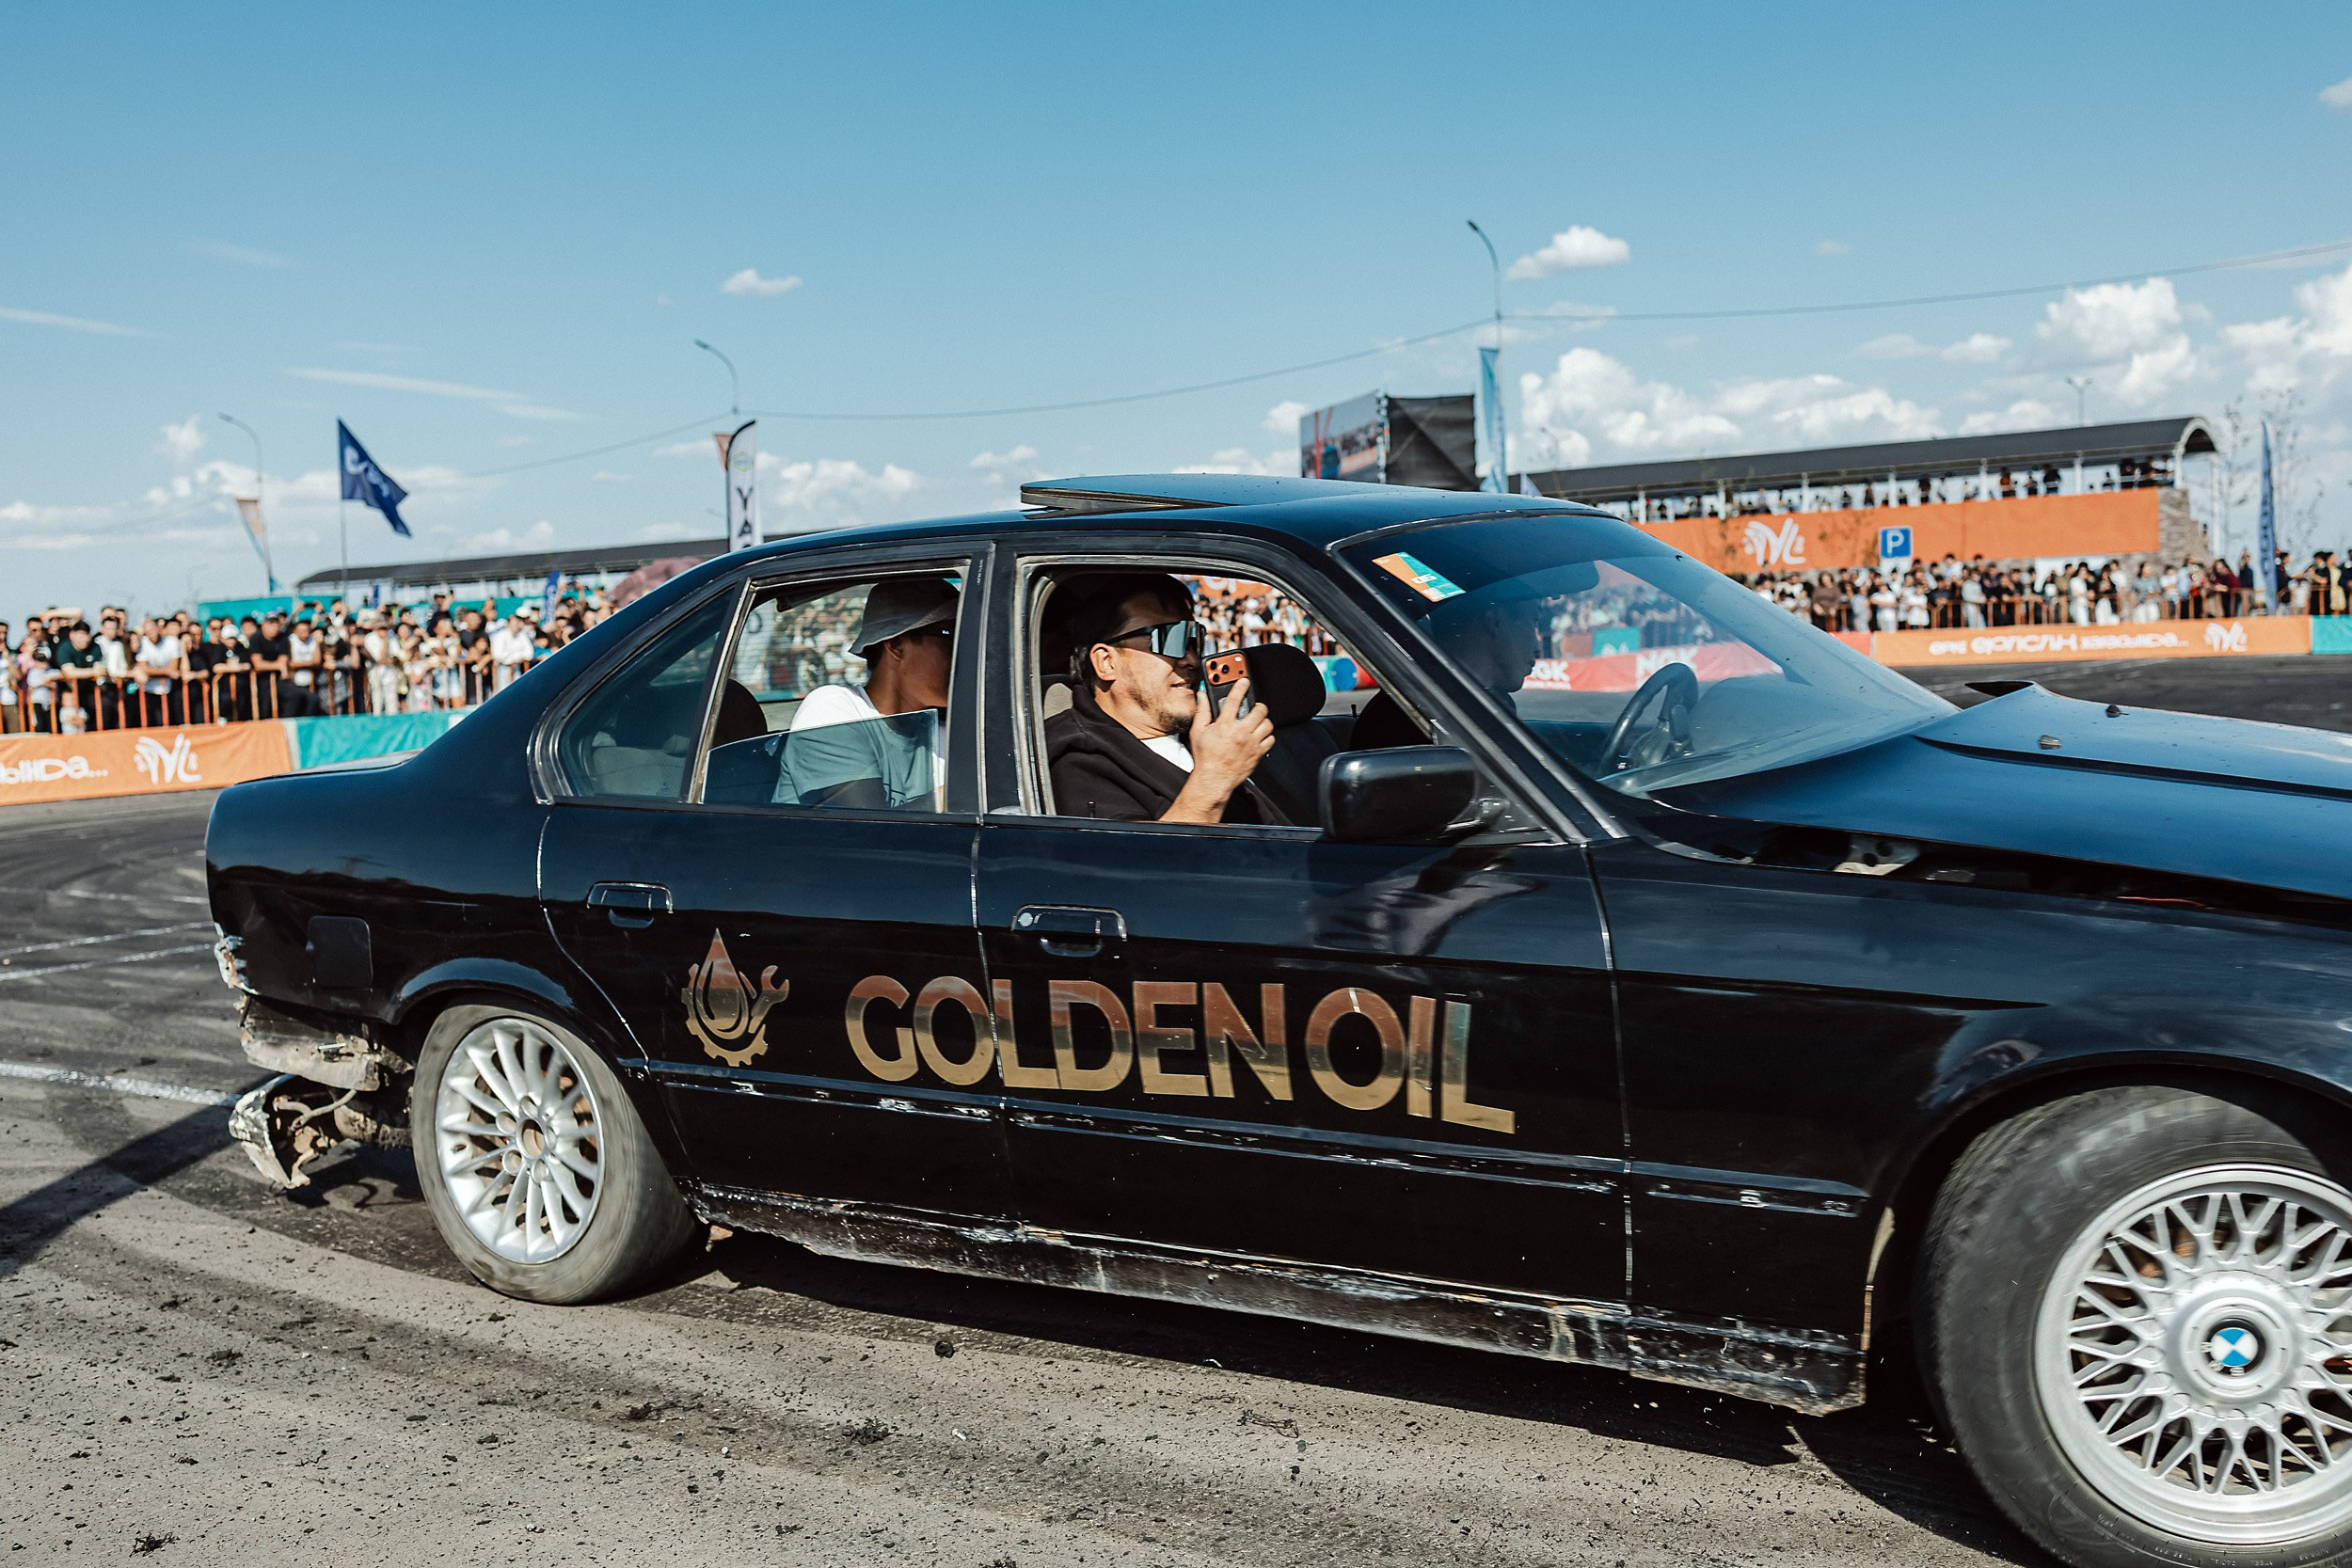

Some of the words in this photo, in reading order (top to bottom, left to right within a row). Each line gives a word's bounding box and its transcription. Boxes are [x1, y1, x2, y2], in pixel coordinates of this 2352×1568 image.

[1886, 530, 1904, 555] P
[1532, 660, 1570, 680] GK
[845, 974, 1294, 1101] GOLDEN
[1304, 987, 1516, 1134] OIL
